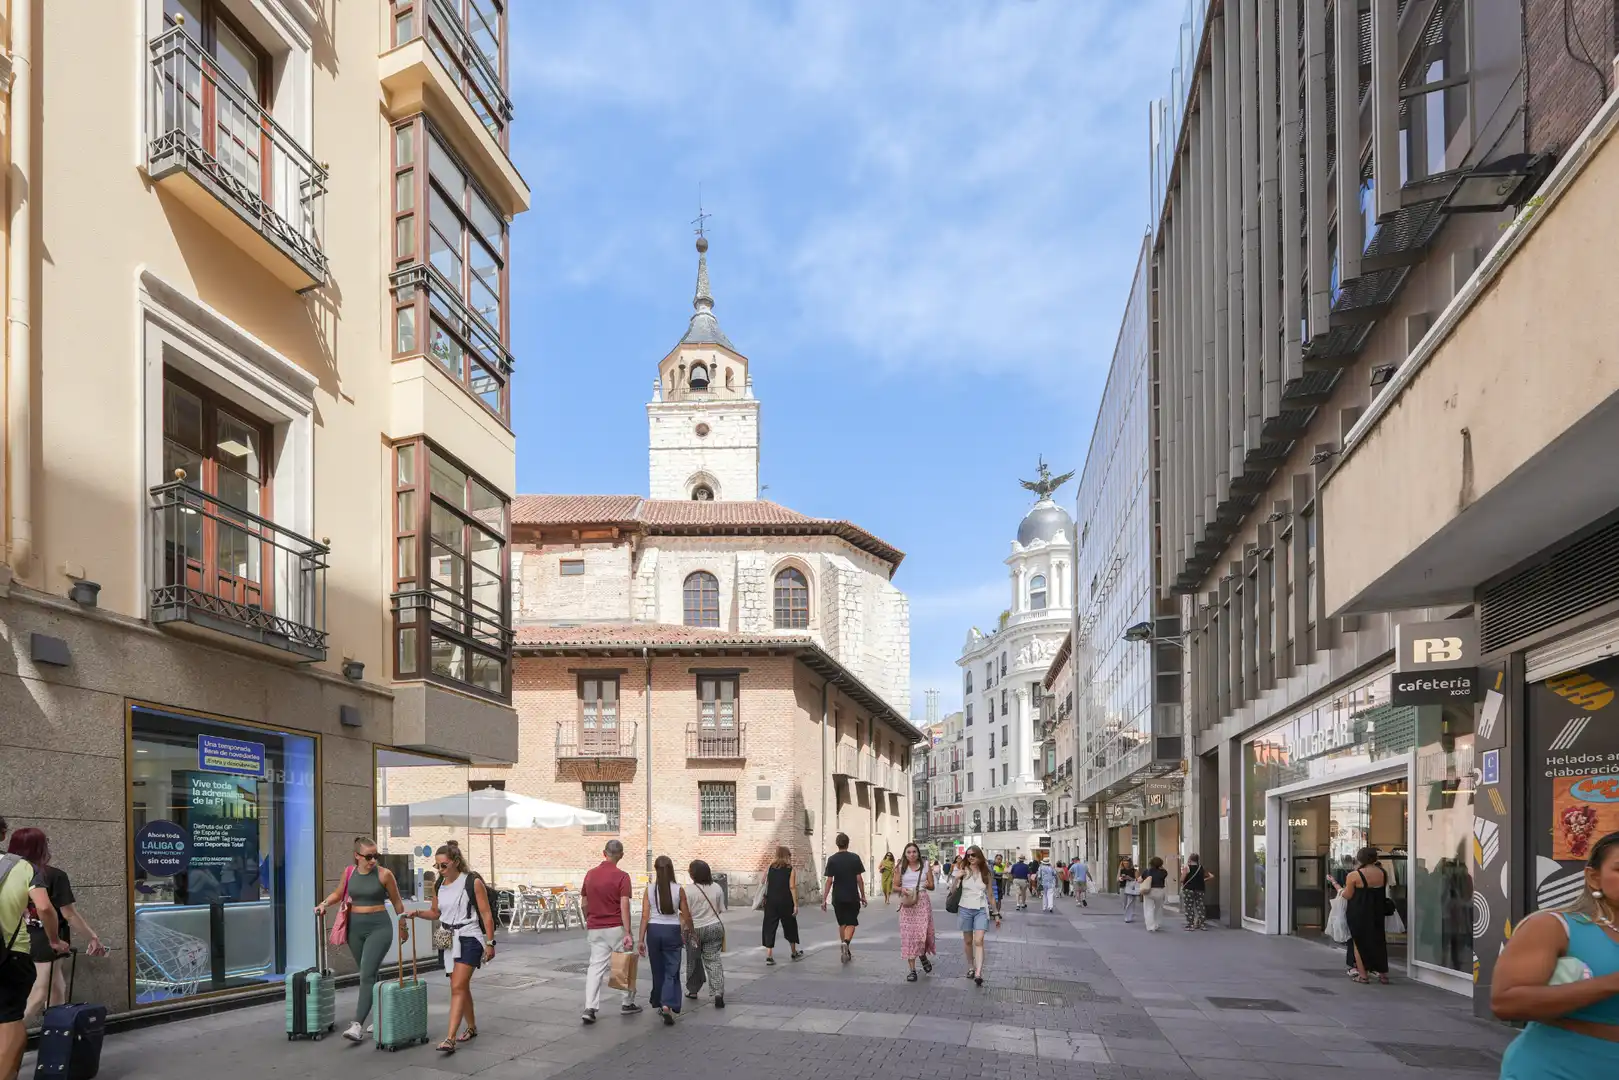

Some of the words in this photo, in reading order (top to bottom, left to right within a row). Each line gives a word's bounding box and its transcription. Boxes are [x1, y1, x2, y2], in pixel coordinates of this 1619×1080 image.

[1398, 677, 1470, 692] cafetería
[204, 740, 217, 748] Una
[218, 743, 251, 752] temporada
[1288, 719, 1351, 762] PULL&BEAR
[229, 752, 260, 760] novedades
[1546, 753, 1603, 765] Helados
[192, 779, 211, 788] Vive
[213, 780, 232, 790] toda
[192, 788, 201, 796] la
[202, 788, 244, 798] adrenalina
[192, 797, 204, 805] de
[206, 797, 213, 805] la
[215, 798, 224, 806] F1
[142, 841, 174, 850] LALIGA
